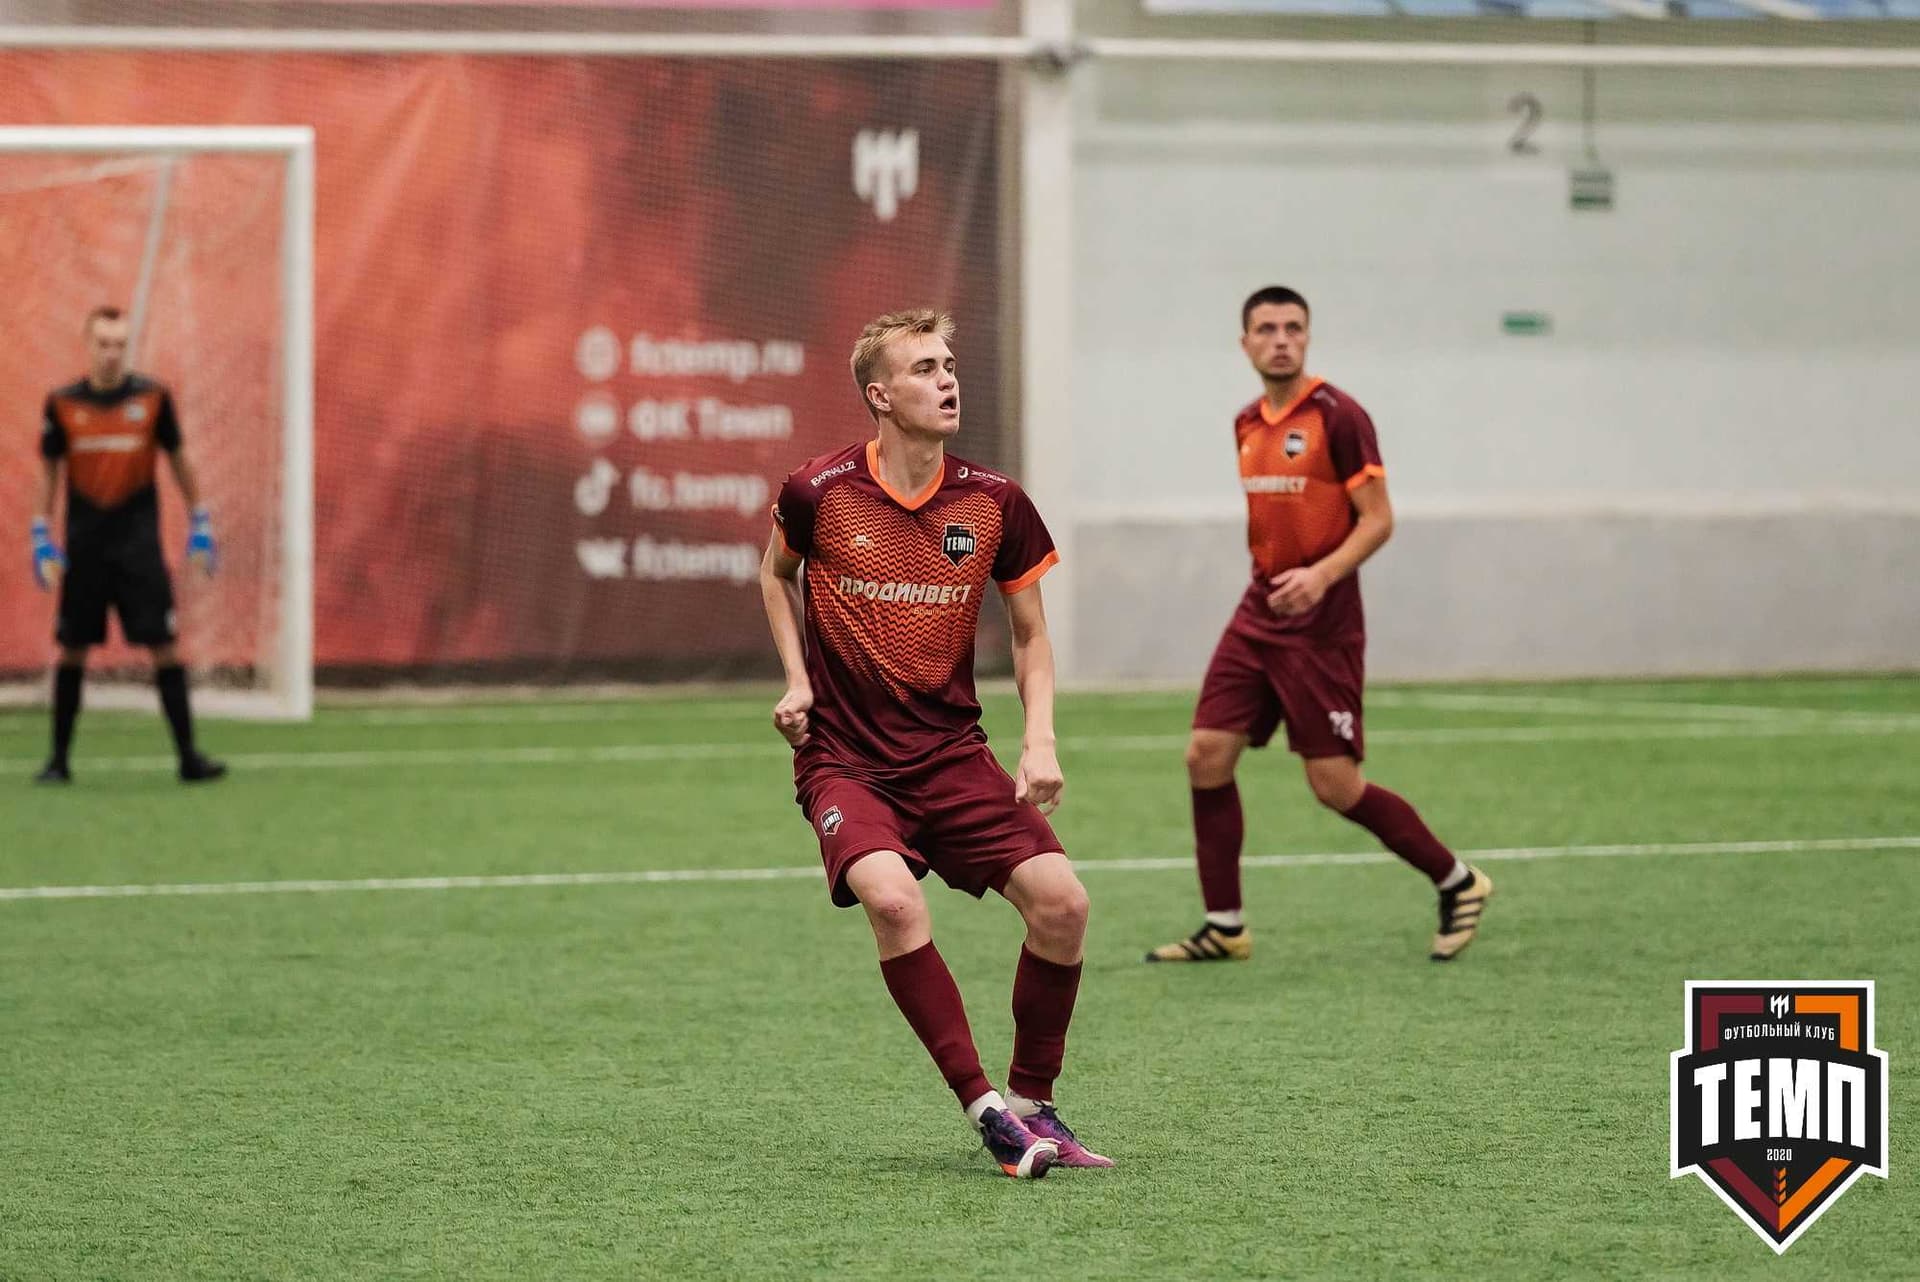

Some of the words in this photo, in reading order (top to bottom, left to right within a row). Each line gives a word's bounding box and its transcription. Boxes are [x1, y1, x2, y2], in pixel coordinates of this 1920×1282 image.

[1507, 91, 1543, 155] 2
[946, 536, 974, 553] ТЕМП
[840, 575, 971, 604] ПРОДИНВЕСТ
